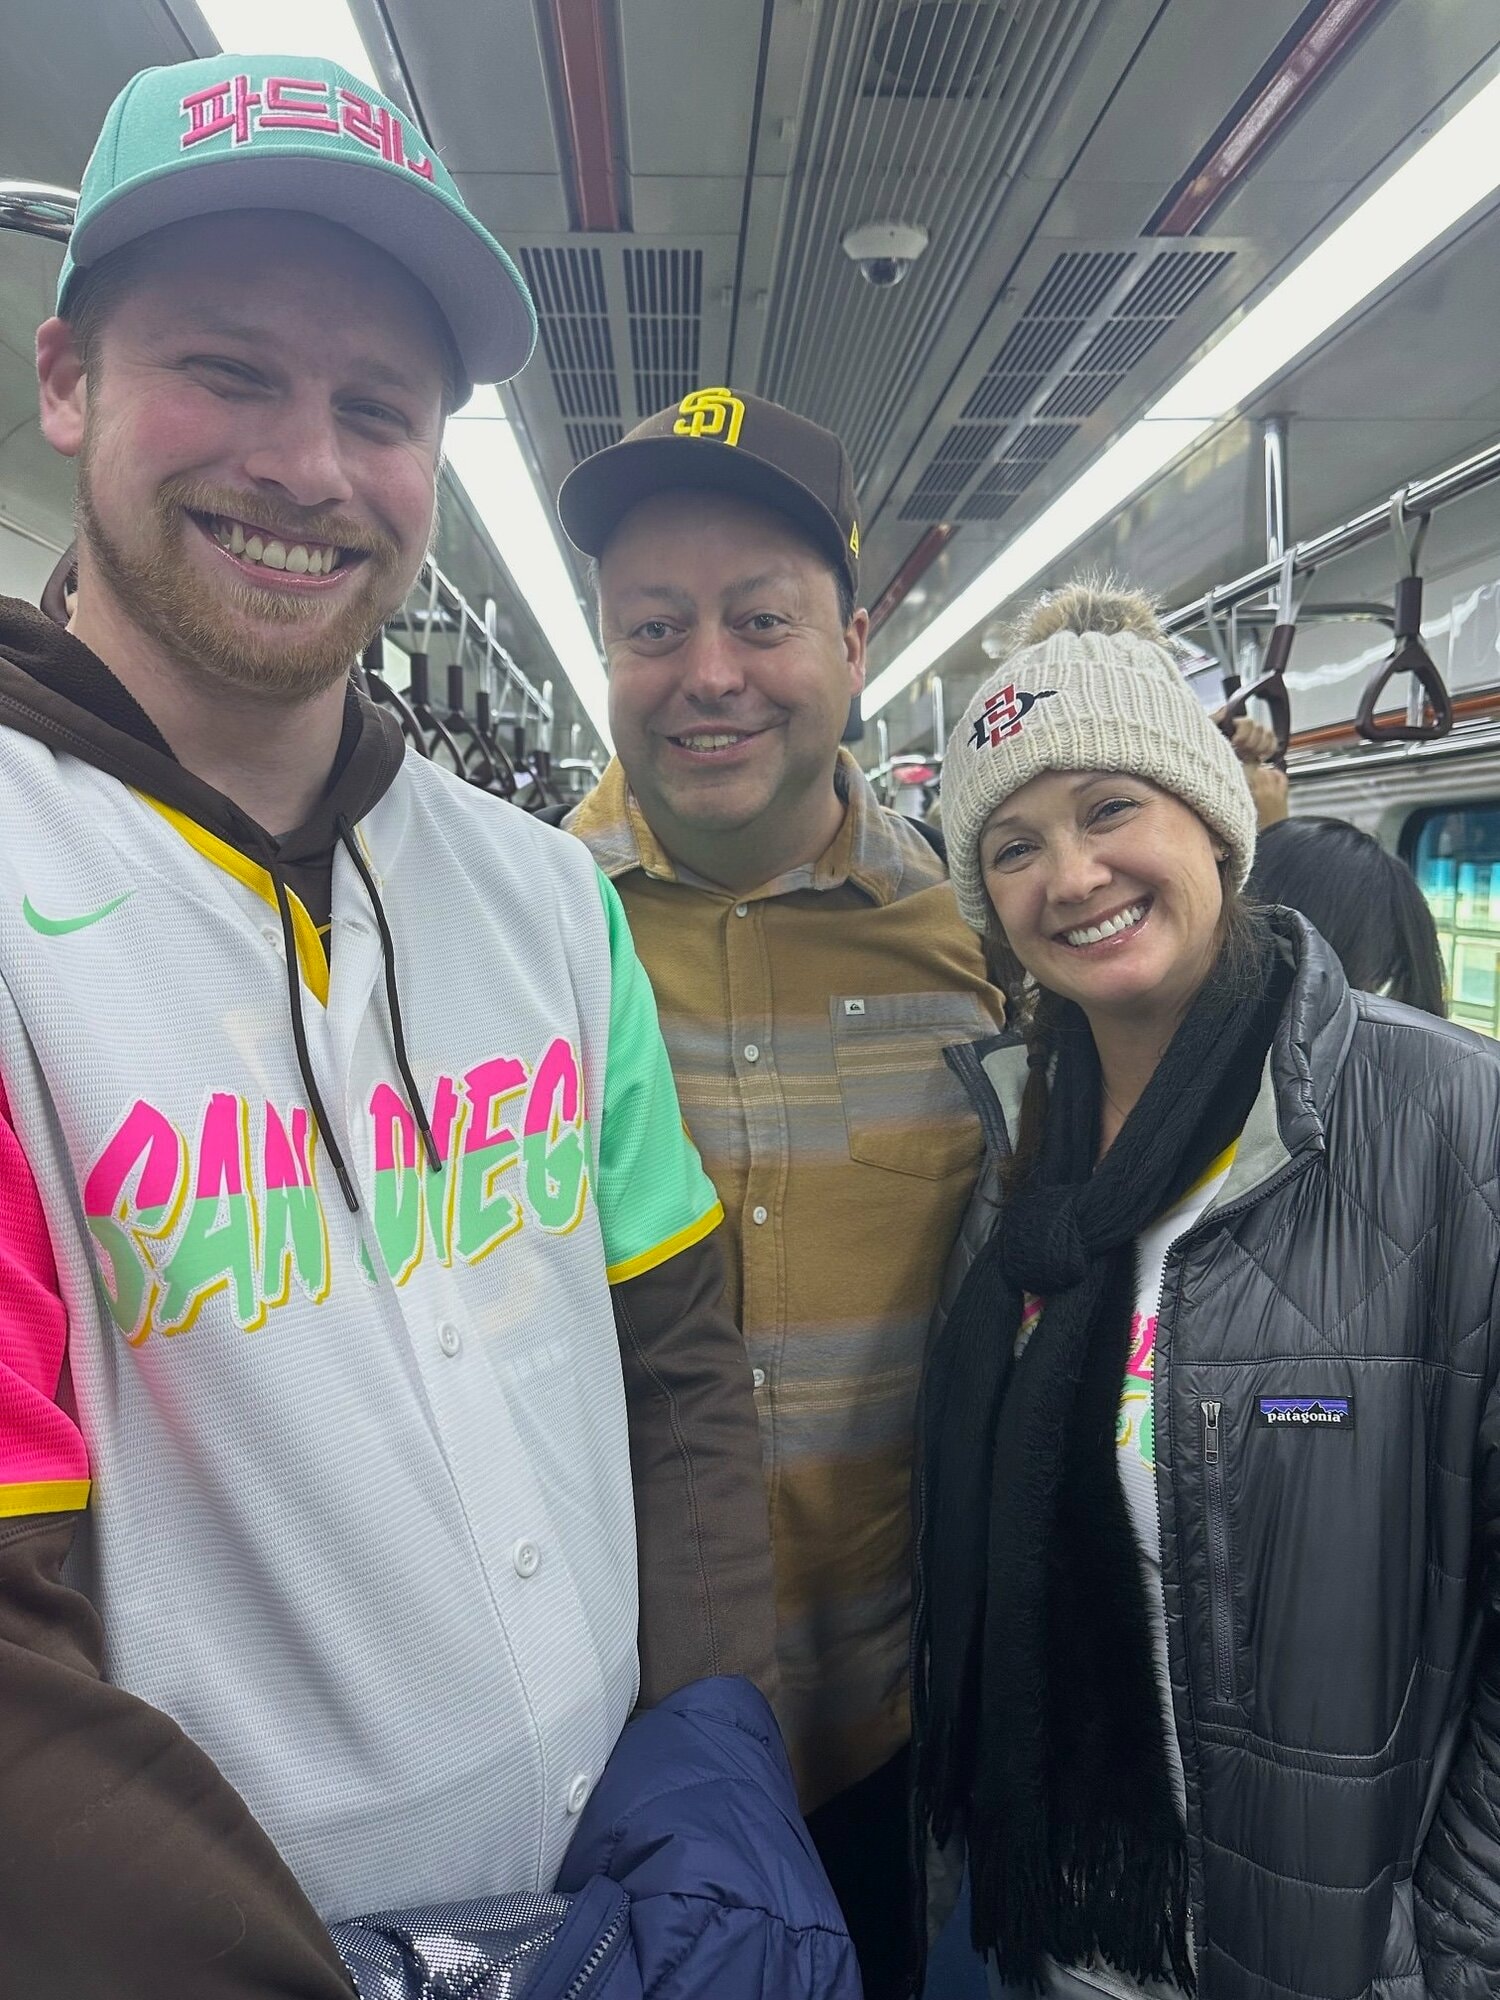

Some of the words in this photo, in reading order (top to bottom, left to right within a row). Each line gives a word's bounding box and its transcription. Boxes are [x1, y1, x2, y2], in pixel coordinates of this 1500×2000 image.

[82, 1091, 332, 1348] SAN
[355, 1036, 598, 1289] DIEG
[1267, 1411, 1341, 1424] patagonia
